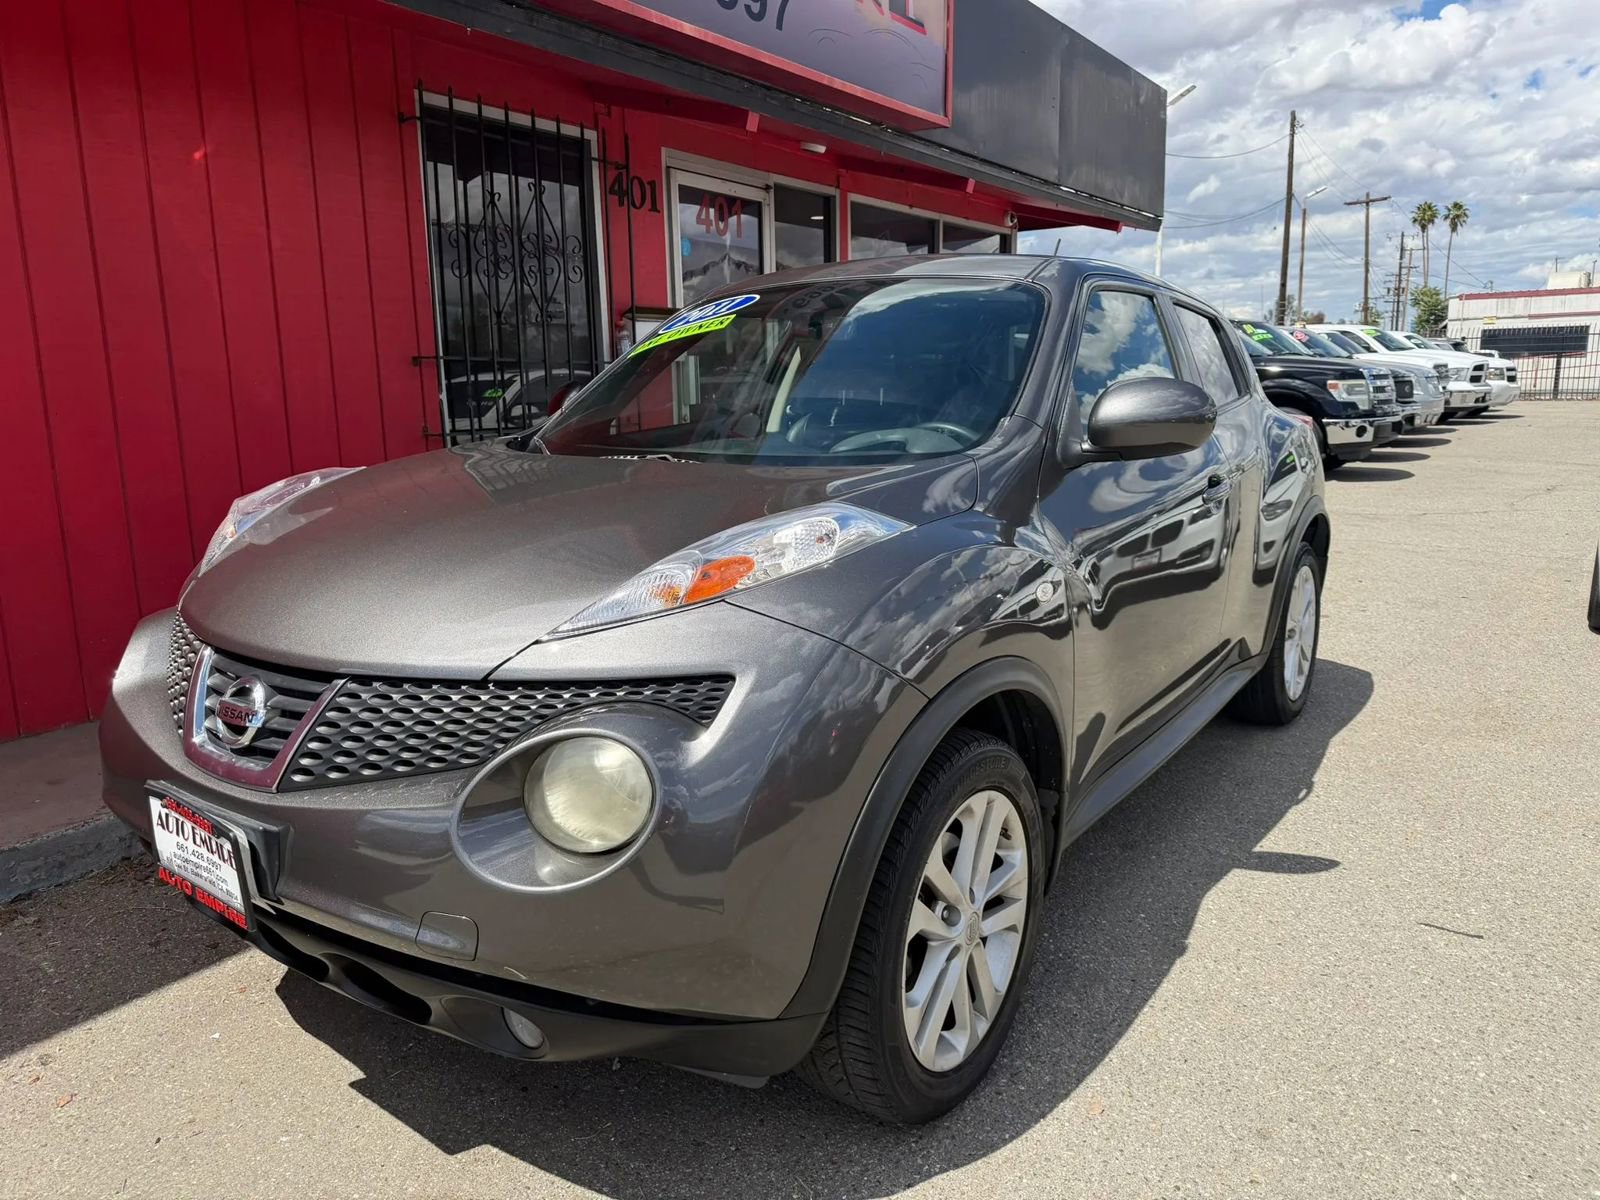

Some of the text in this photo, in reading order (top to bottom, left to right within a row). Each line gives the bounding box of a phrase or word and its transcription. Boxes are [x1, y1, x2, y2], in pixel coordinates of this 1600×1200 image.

[608, 172, 661, 213] 401
[696, 195, 743, 239] 401
[156, 809, 237, 871] AUTO EMPIRE
[158, 866, 248, 930] AUTO EMPIRE
